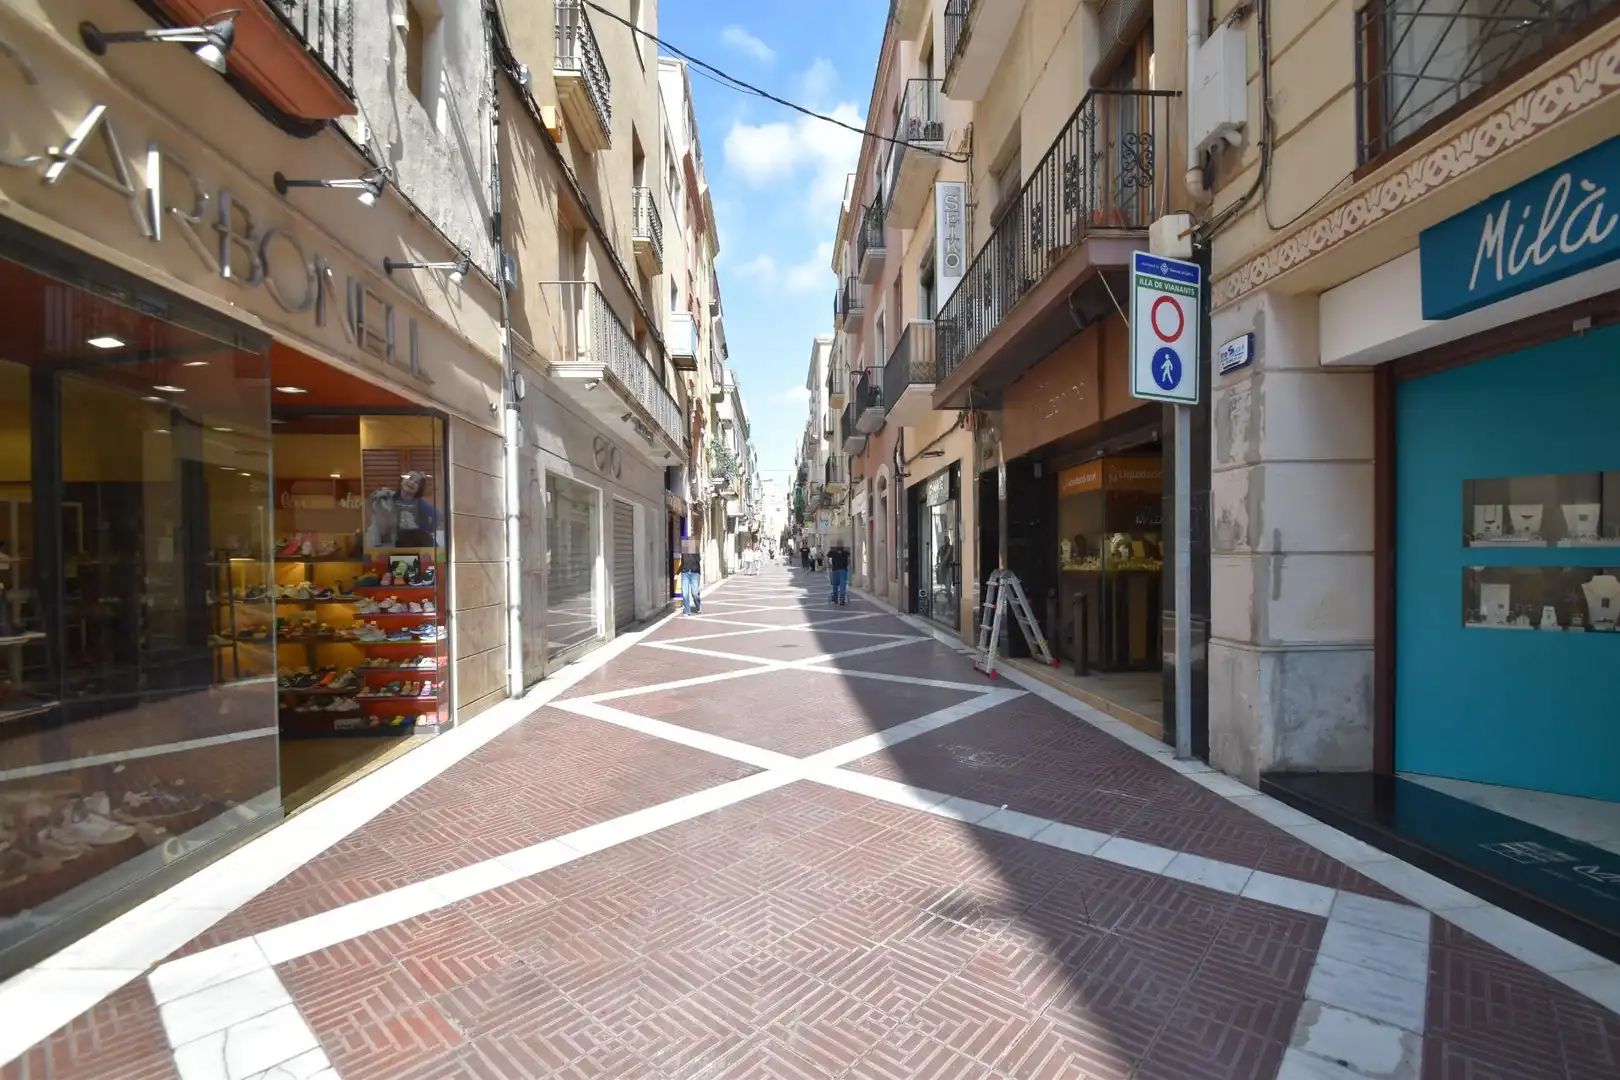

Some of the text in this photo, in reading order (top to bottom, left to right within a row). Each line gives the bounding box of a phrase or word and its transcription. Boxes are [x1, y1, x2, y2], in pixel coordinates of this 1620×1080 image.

[1467, 172, 1619, 292] Milà
[1139, 277, 1195, 296] ILLA DE VIANANTS
